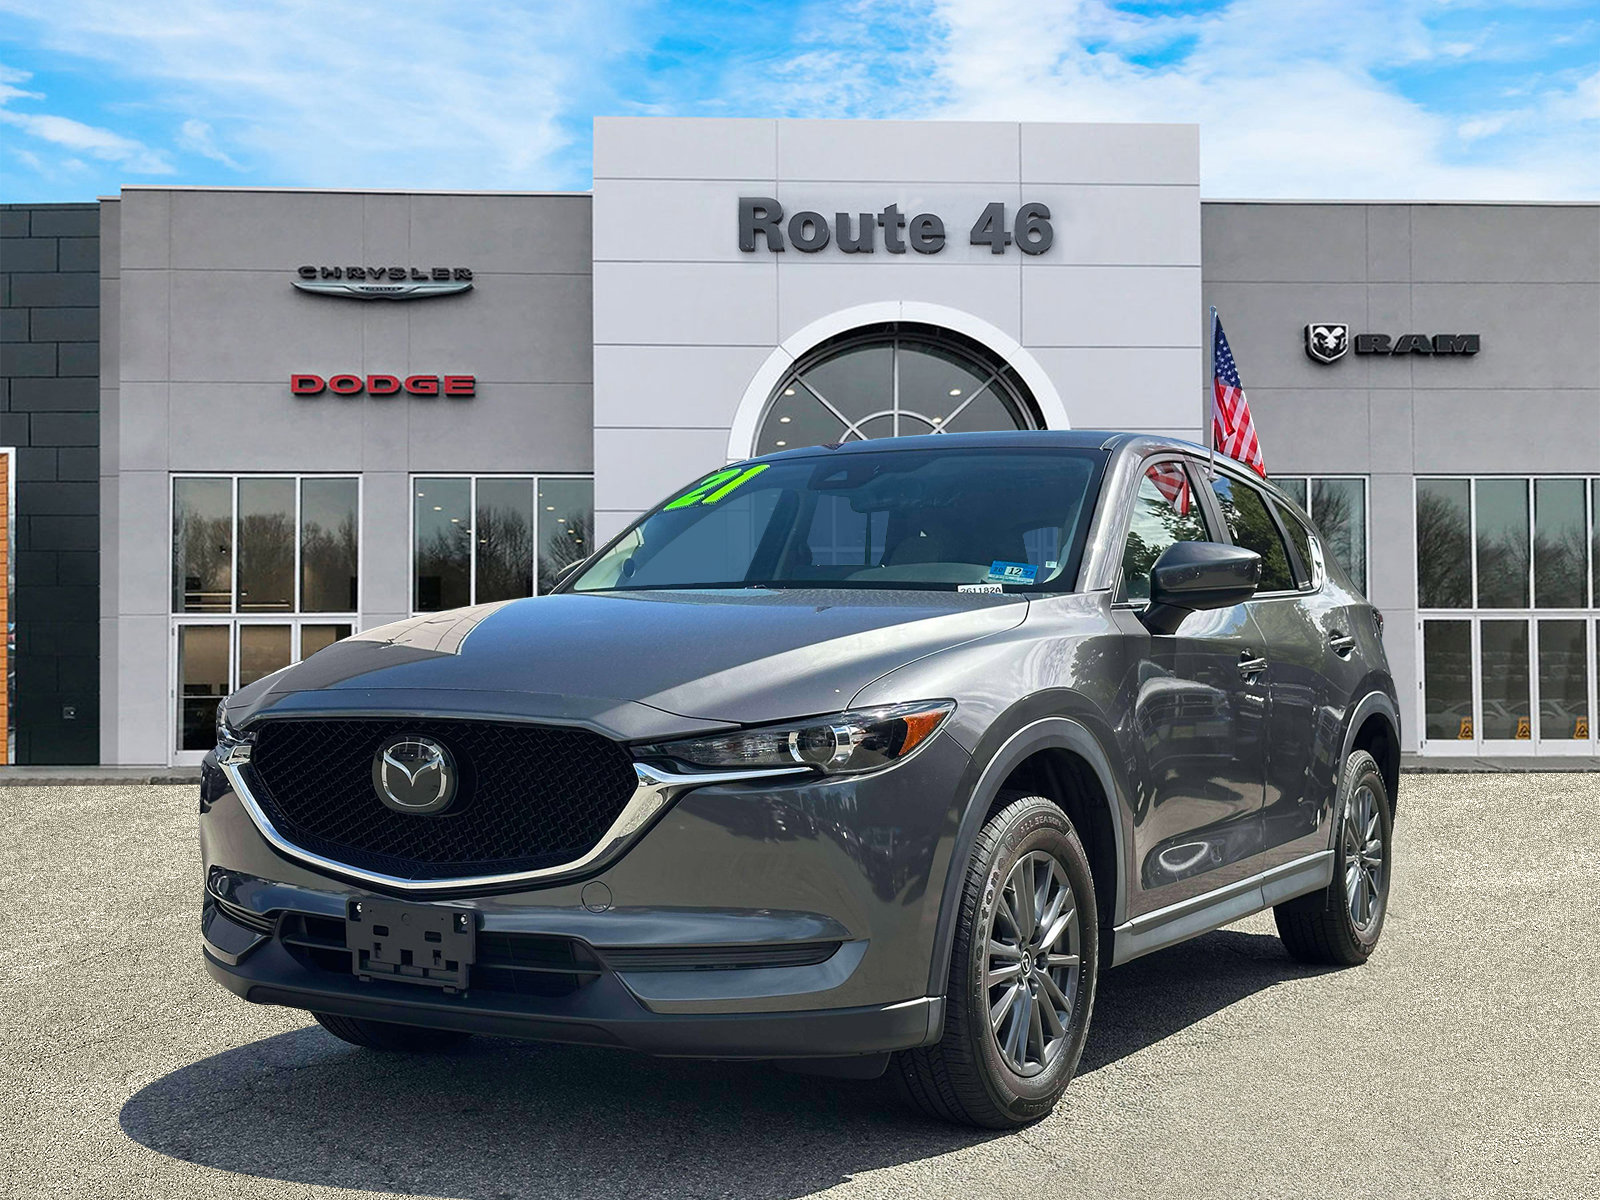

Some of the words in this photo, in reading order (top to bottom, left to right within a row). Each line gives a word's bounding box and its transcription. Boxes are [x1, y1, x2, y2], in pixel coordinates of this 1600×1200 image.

[738, 197, 946, 253] Route
[969, 202, 1054, 255] 46
[298, 266, 473, 280] CHRYSLER
[1355, 334, 1480, 355] RAM
[291, 374, 476, 396] DODGE
[663, 464, 770, 512] 21
[1008, 567, 1022, 576] 12
